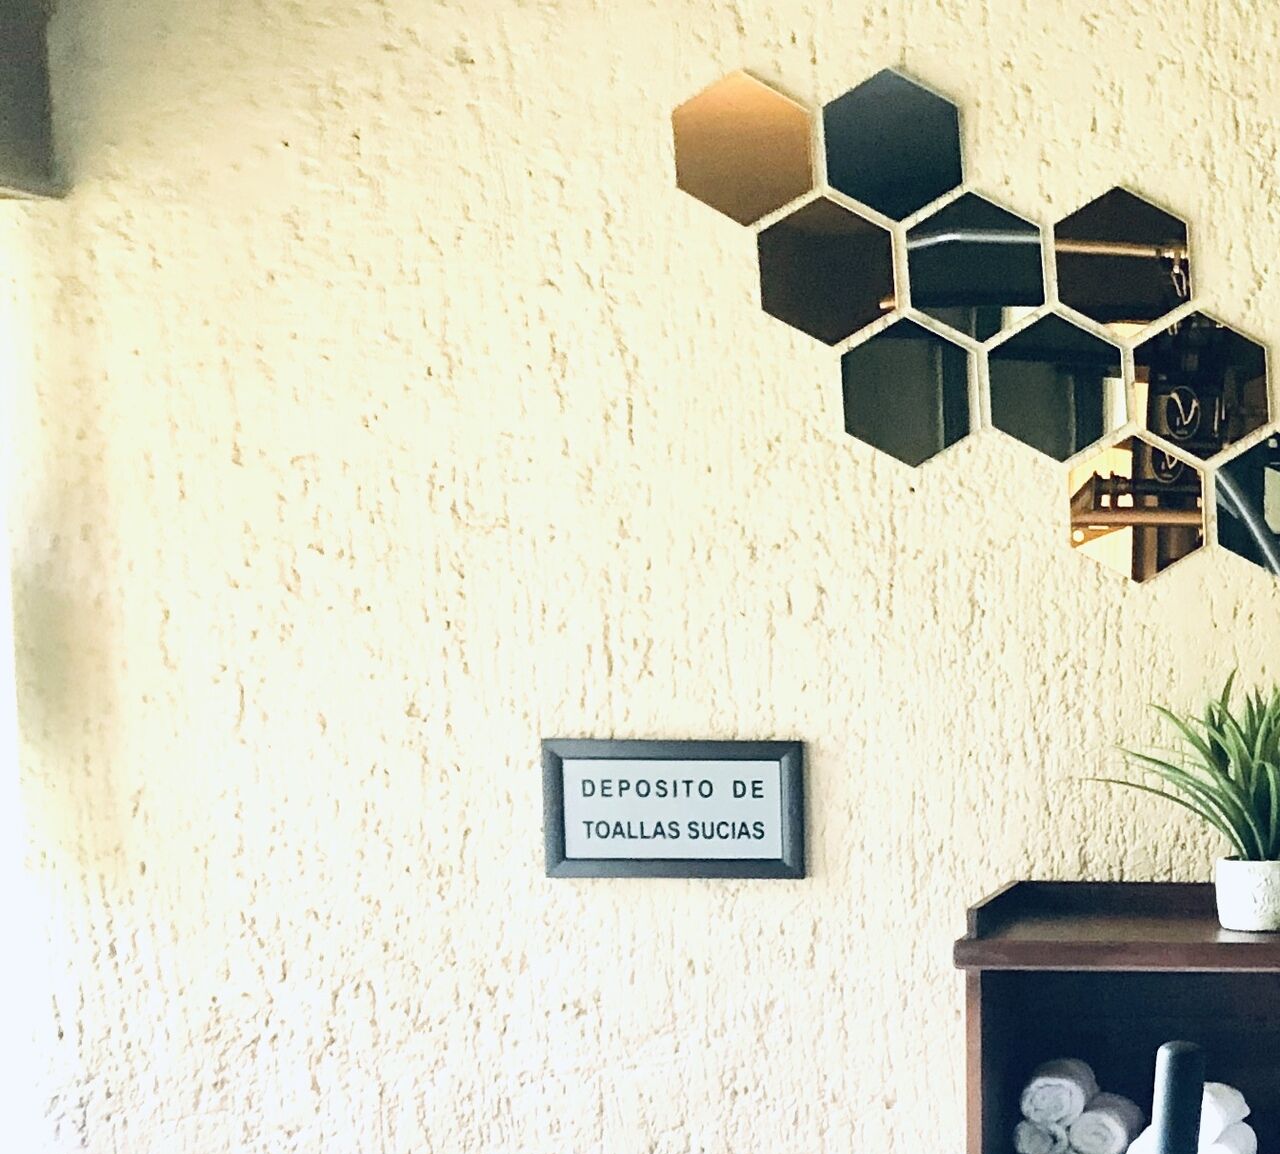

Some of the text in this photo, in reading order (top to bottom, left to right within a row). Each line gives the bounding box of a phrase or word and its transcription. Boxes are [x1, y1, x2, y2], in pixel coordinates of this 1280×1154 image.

[581, 779, 765, 798] DEPOSITO DE
[582, 820, 766, 840] TOALLAS SUCIAS
